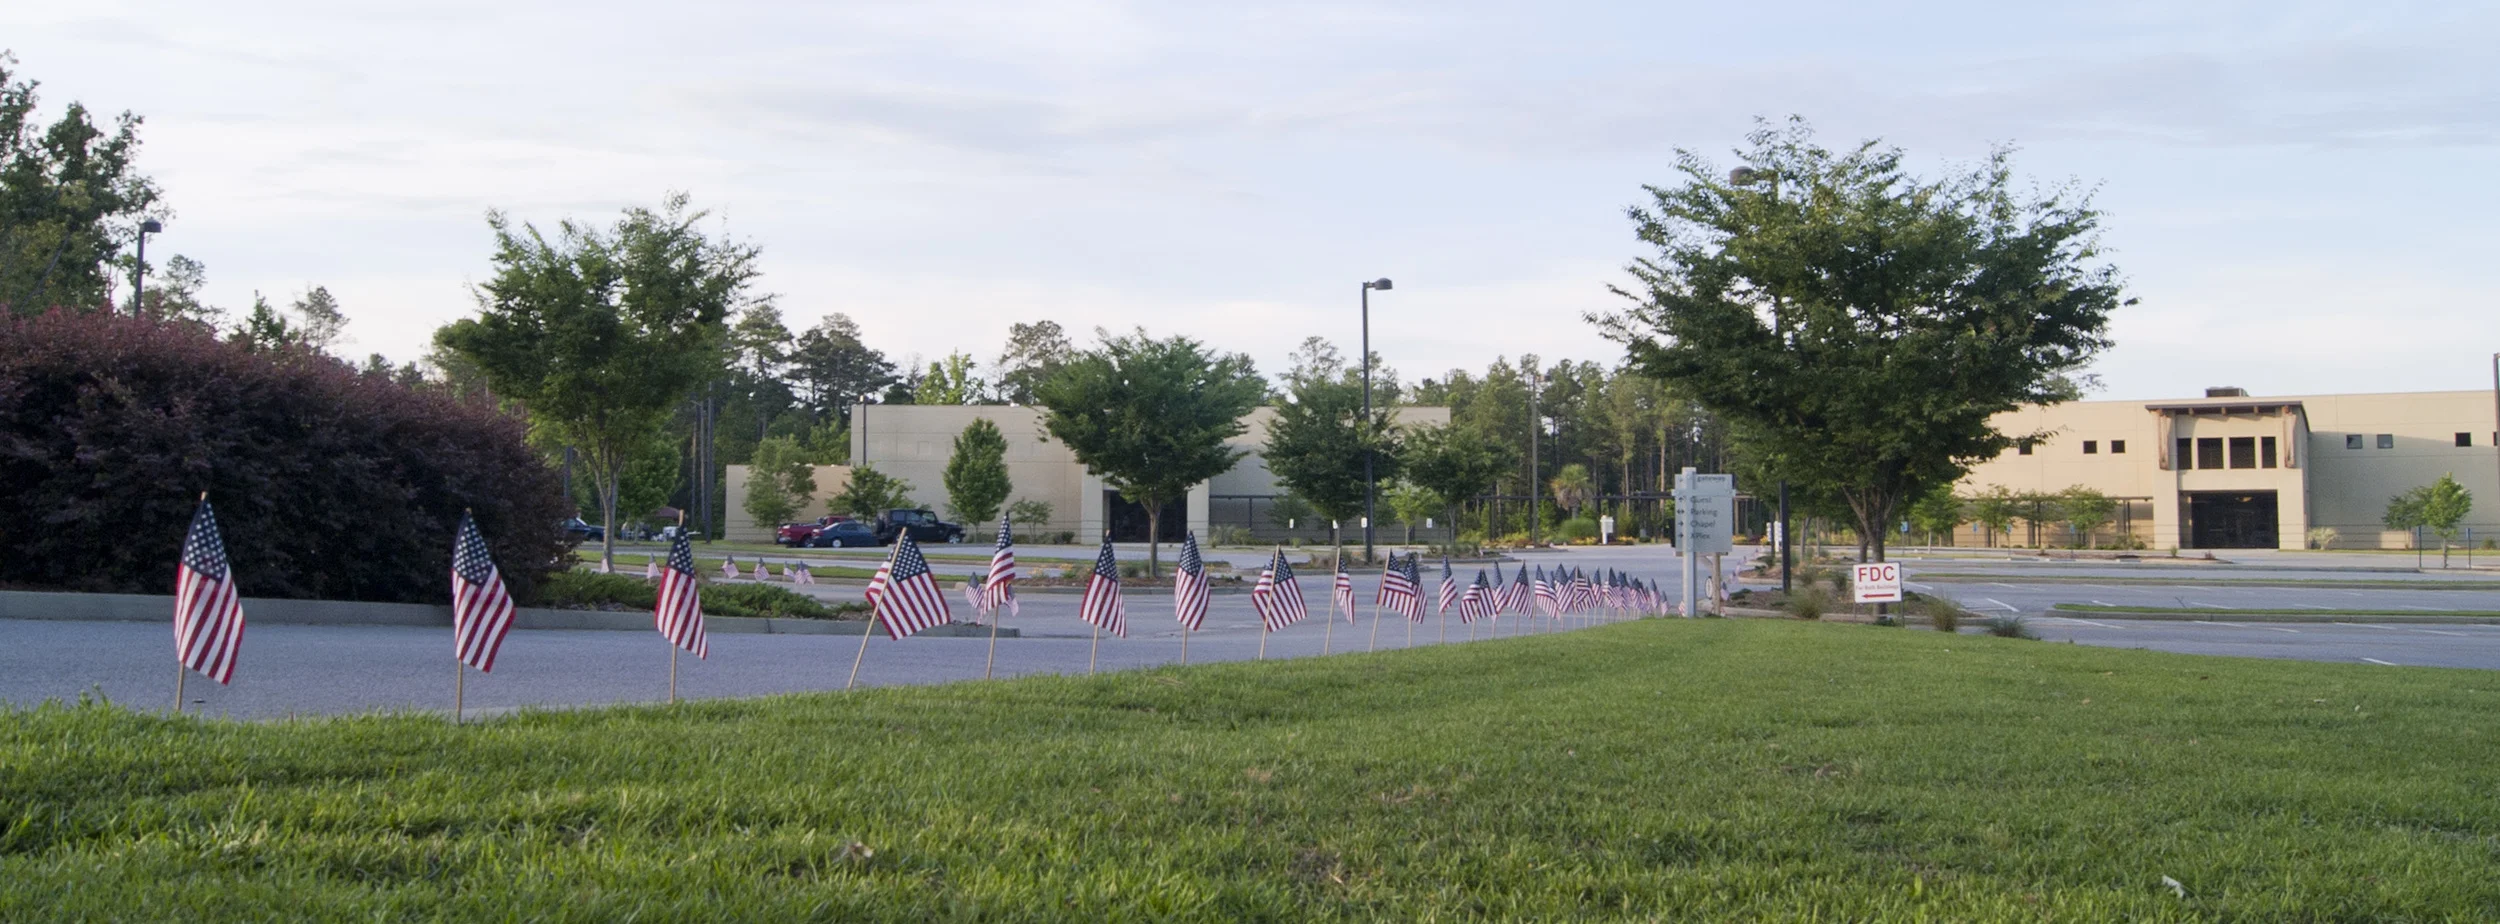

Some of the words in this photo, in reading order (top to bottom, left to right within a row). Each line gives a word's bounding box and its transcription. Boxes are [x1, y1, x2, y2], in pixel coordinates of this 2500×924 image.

[1690, 508, 1718, 517] Parking
[1690, 520, 1716, 528] Chapel
[1858, 566, 1895, 582] FDC
